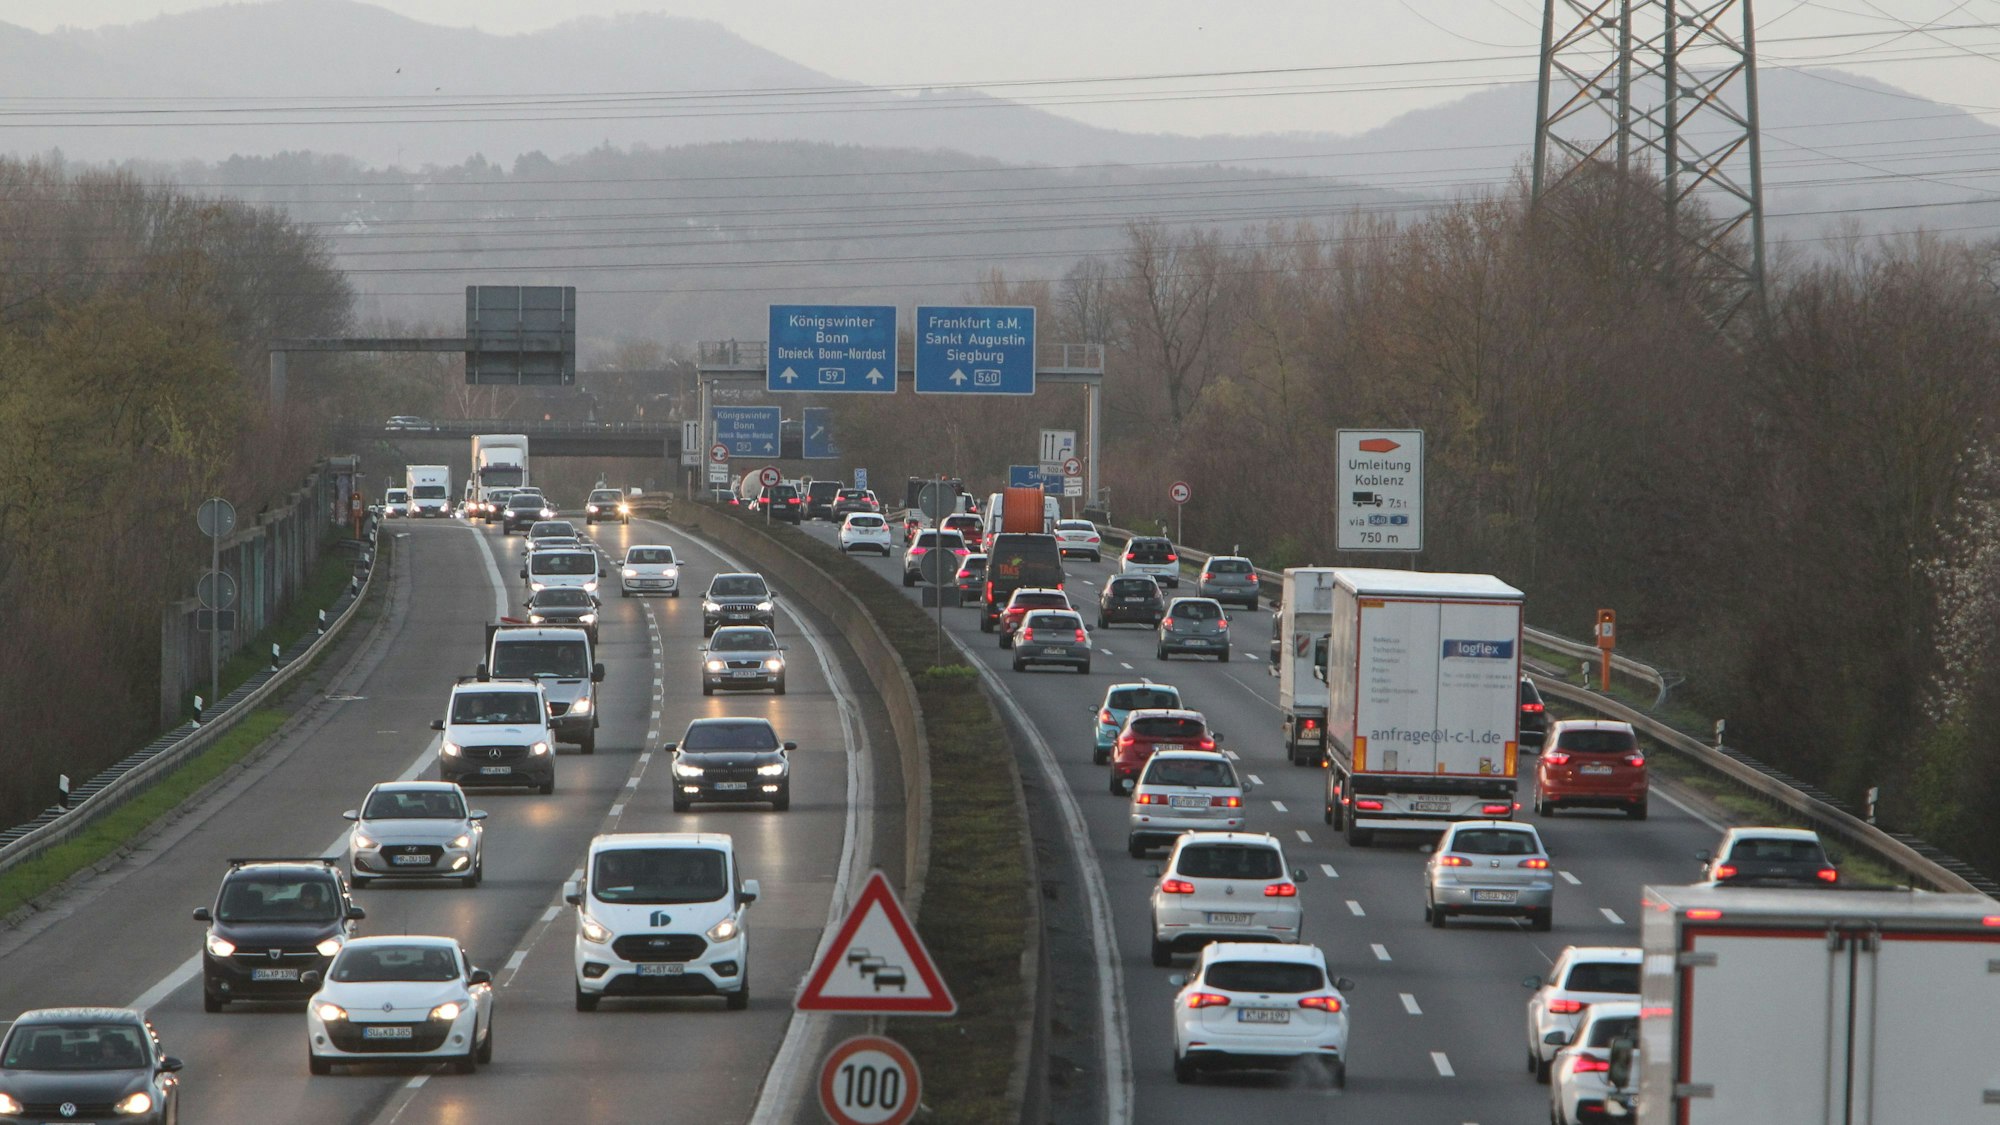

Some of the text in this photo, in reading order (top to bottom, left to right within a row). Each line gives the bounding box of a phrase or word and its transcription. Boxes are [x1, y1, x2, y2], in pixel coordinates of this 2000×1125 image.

[789, 315, 875, 329] Königswinter
[929, 317, 1022, 329] Frankfurt a.M.
[816, 331, 849, 343] Bonn
[926, 332, 1025, 348] Sankt Augustin
[778, 347, 886, 360] Dreieck Bonn-Nordost
[947, 349, 1004, 364] Siegburg
[825, 370, 838, 381] 59
[978, 372, 998, 383] 560
[717, 411, 771, 420] Königswinter
[733, 421, 755, 430] Bonn
[1348, 459, 1411, 473] Umleitung
[1355, 475, 1404, 486] Koblenz
[1350, 517, 1365, 526] via
[1371, 516, 1386, 524] 560
[1360, 532, 1399, 543] 750 m
[1458, 642, 1499, 655] logflex
[1371, 727, 1501, 745] anfrage@l-c-l.de
